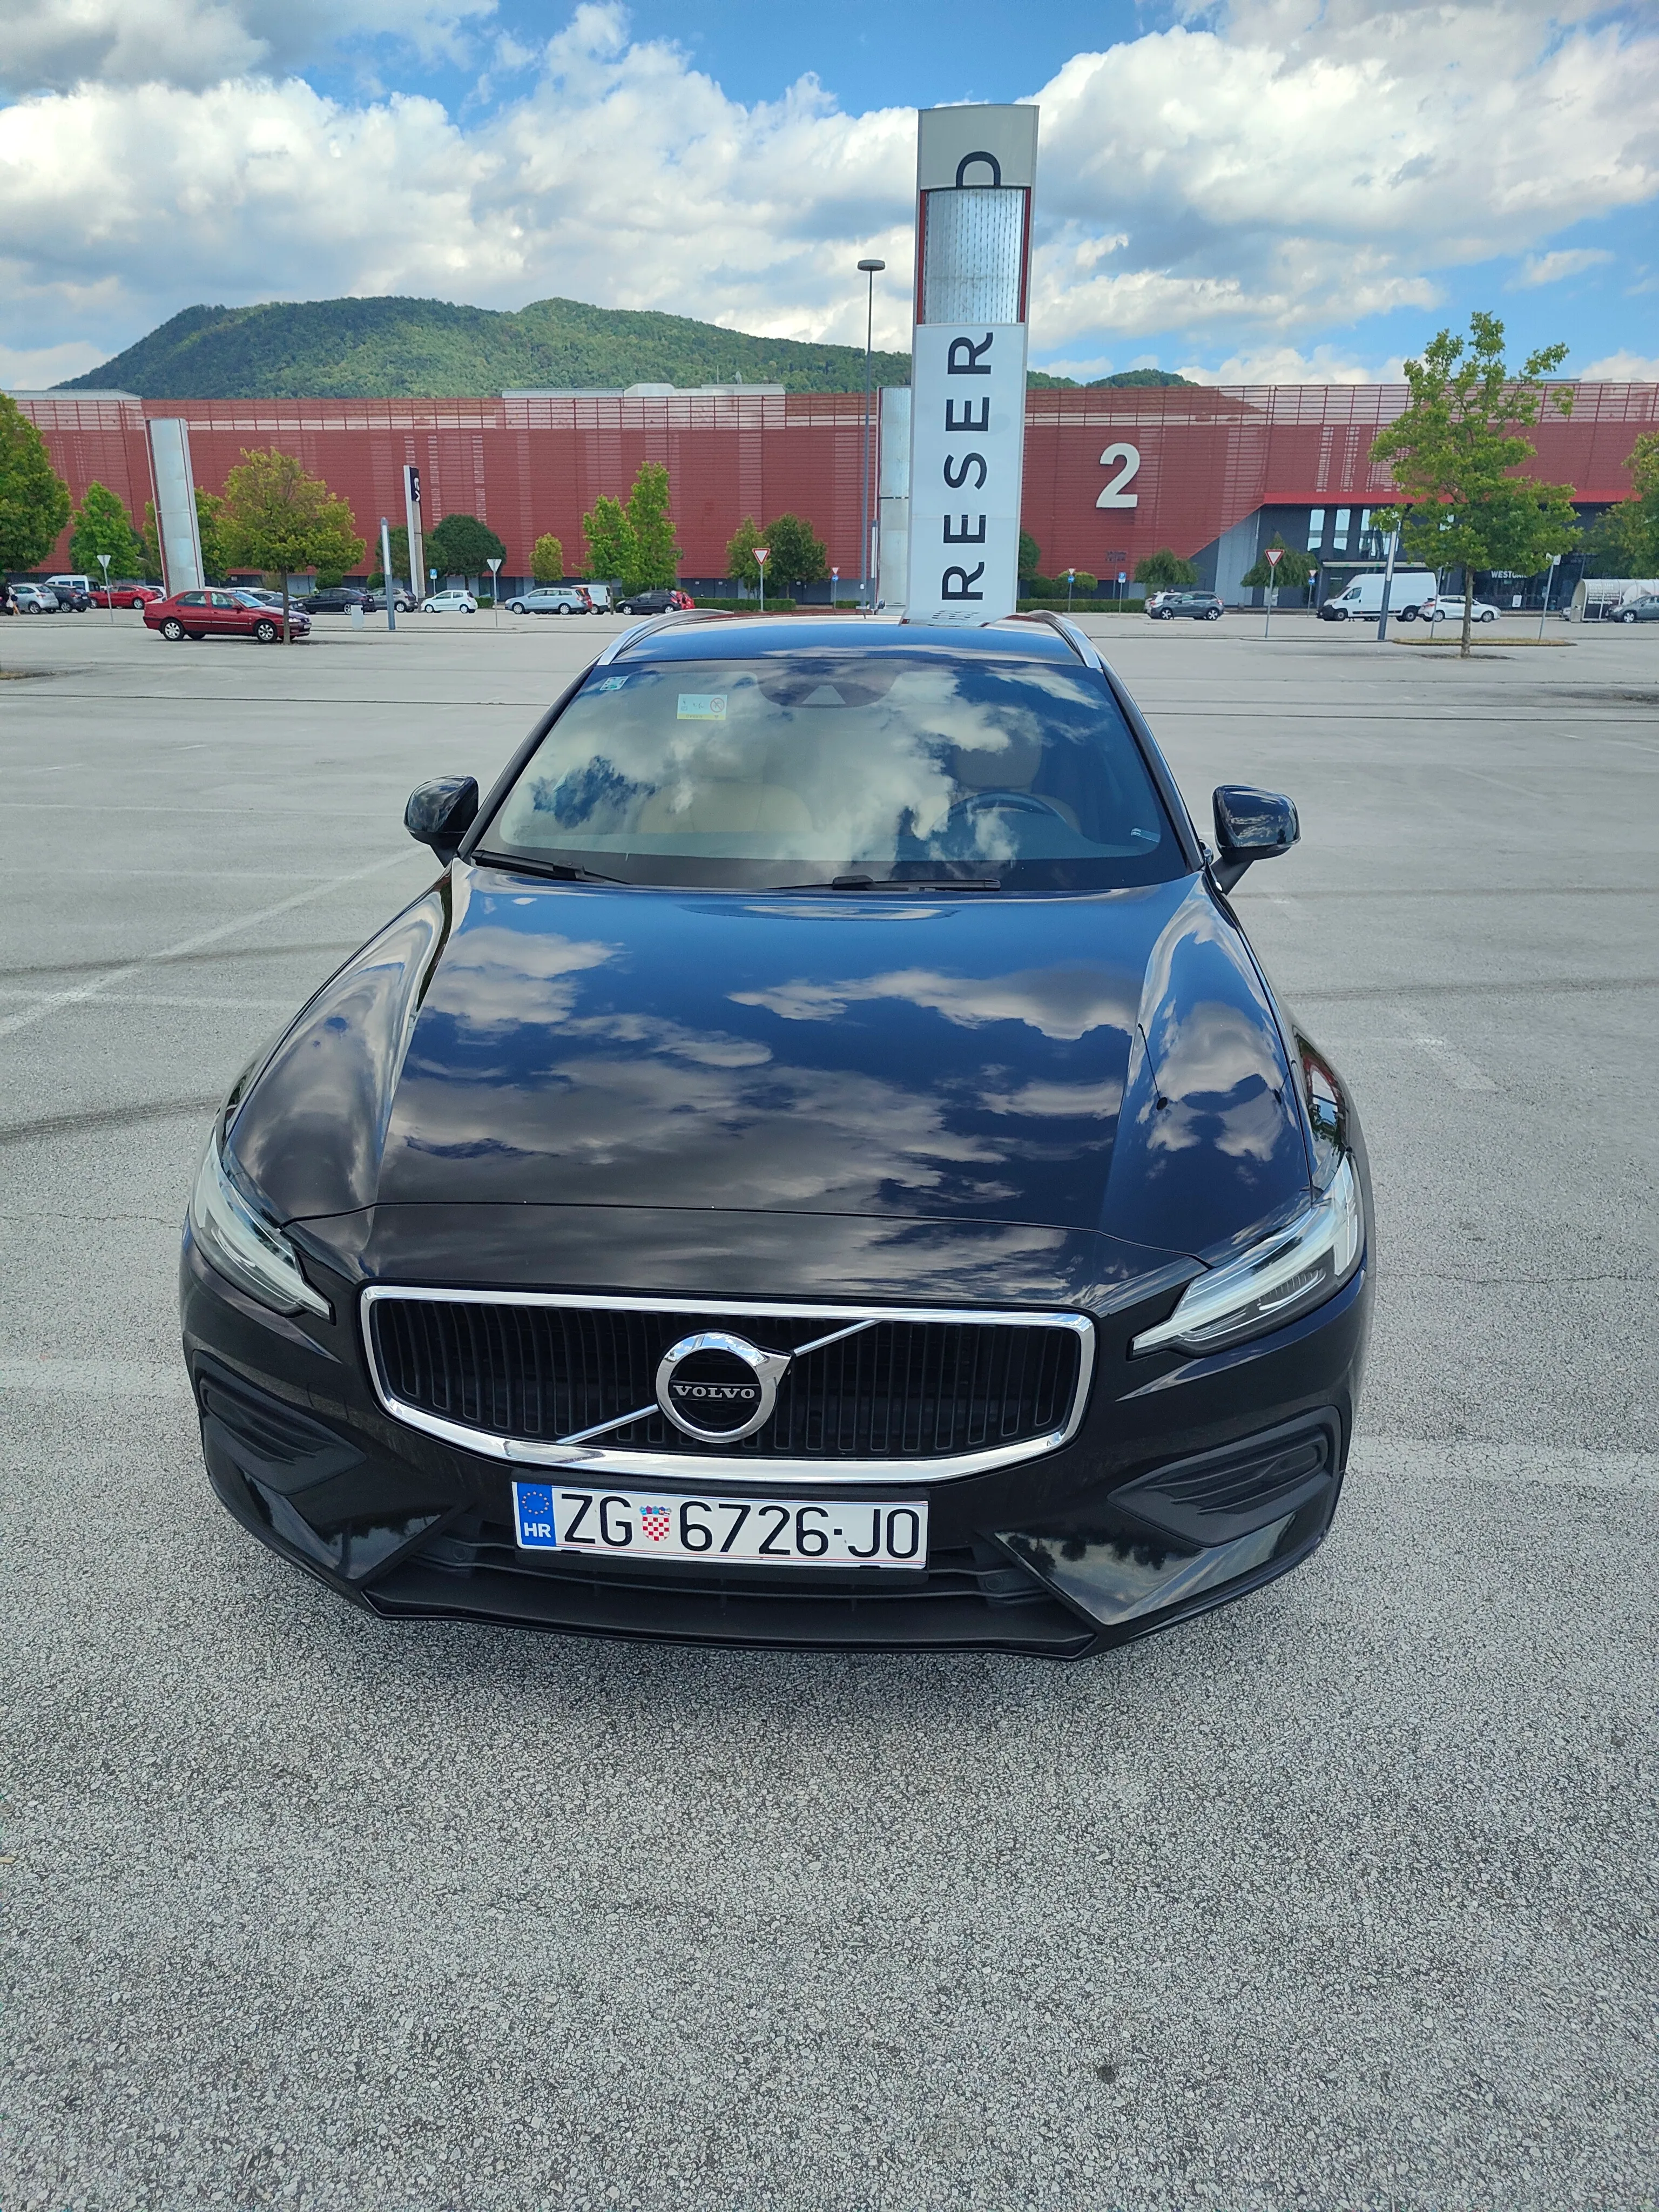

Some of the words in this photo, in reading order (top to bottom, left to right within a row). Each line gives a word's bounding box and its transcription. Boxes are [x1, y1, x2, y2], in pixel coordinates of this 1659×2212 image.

[1096, 442, 1140, 508] 2
[673, 1385, 755, 1399] VOLVO
[523, 1522, 551, 1538] HR
[561, 1493, 633, 1547] ZG
